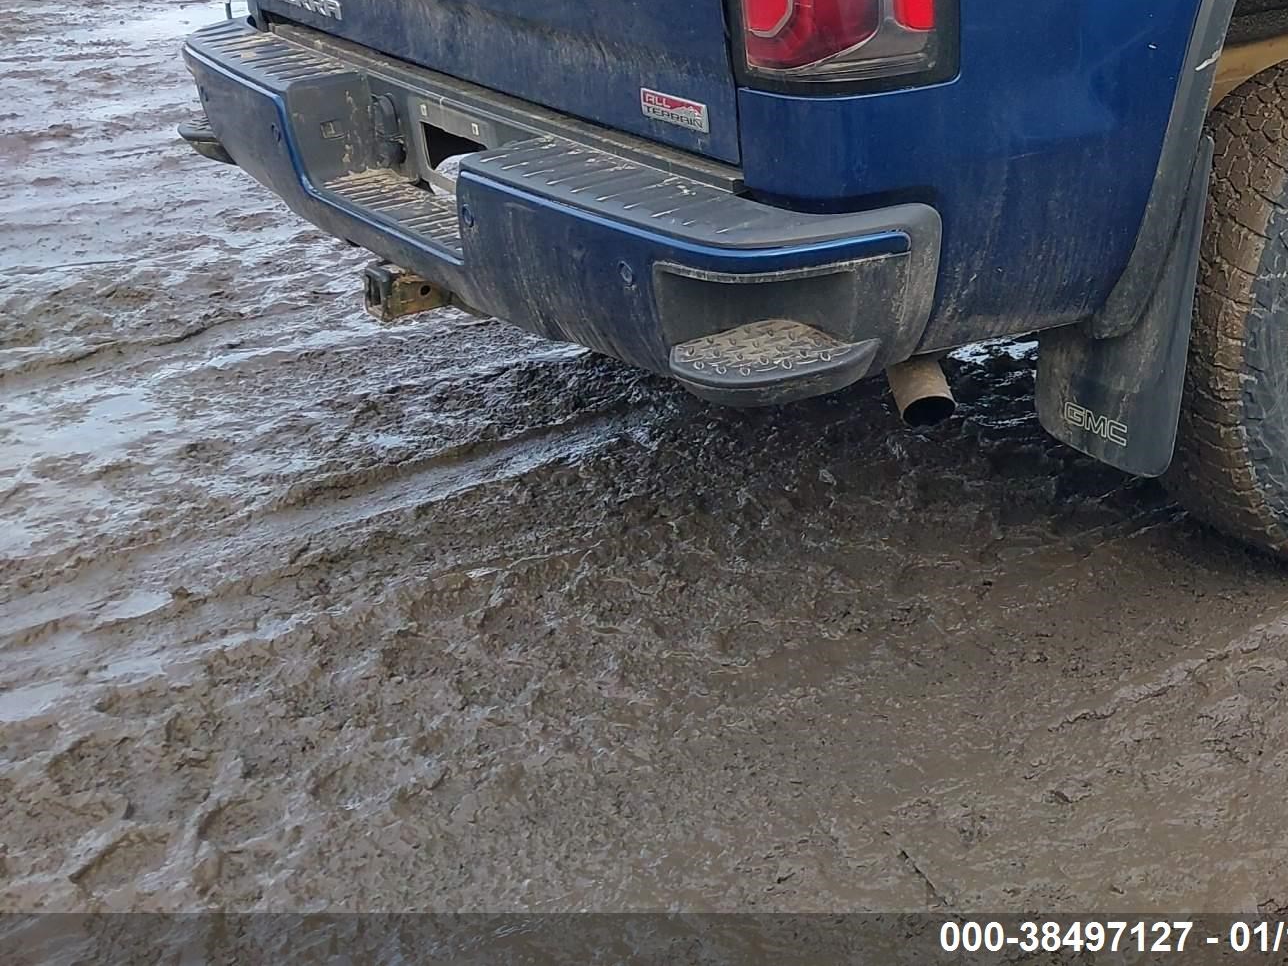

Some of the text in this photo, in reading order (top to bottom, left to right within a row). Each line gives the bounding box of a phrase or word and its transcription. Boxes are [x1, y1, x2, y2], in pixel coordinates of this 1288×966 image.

[645, 93, 672, 109] ALL
[646, 105, 705, 130] TERRAIN
[1064, 401, 1128, 447] GMC
